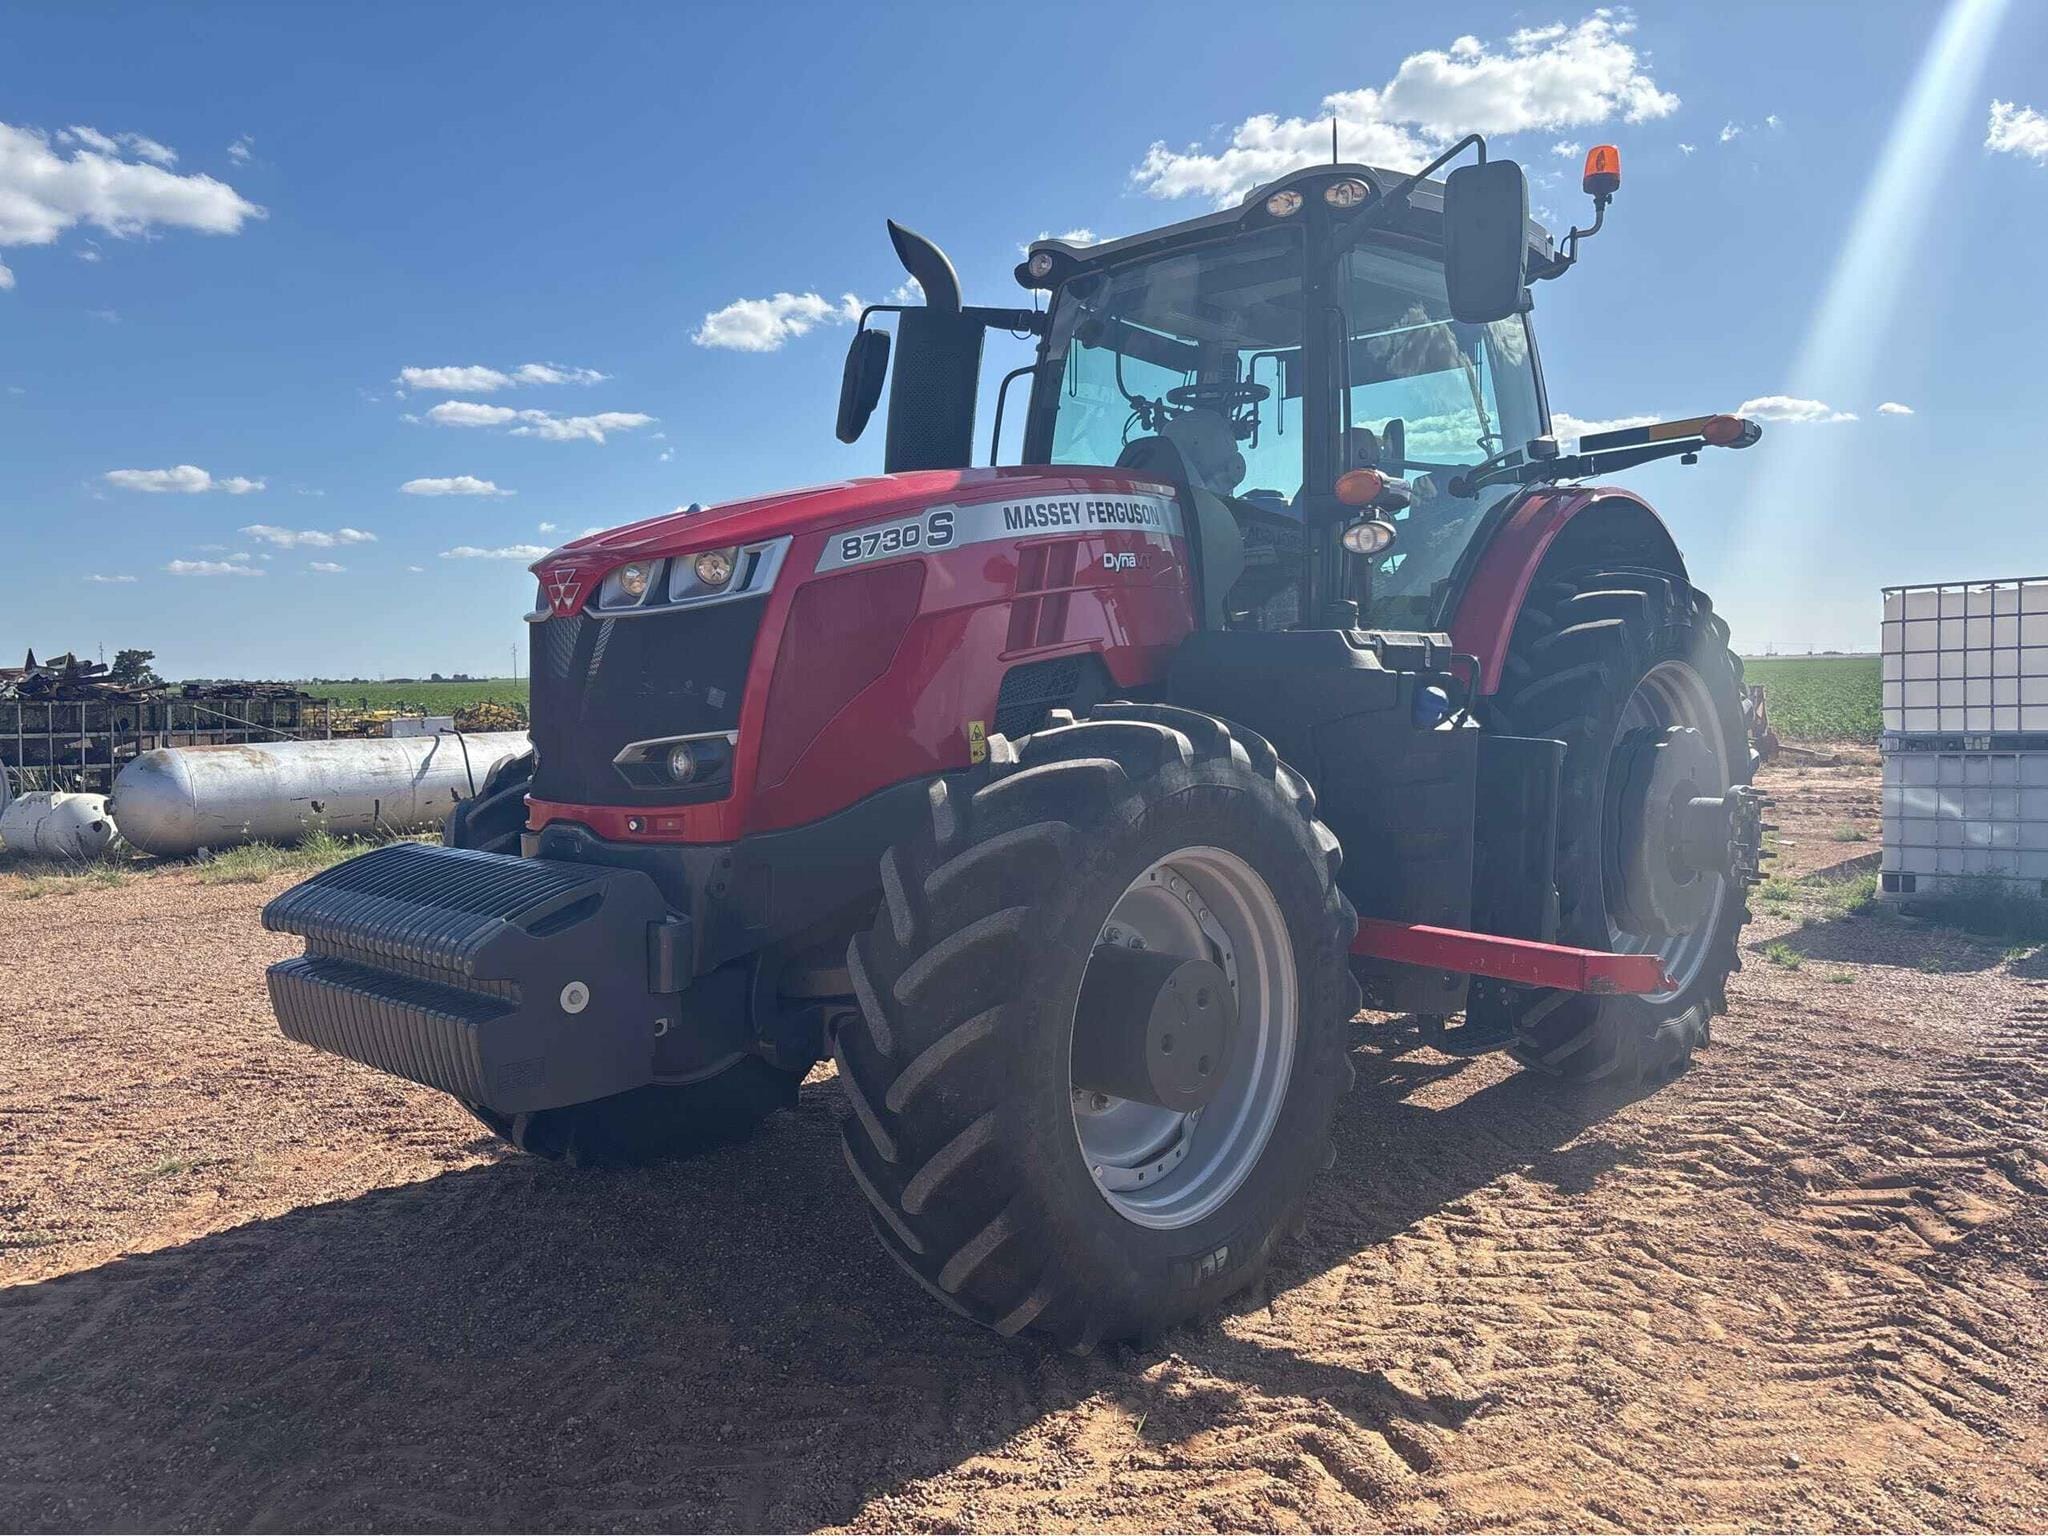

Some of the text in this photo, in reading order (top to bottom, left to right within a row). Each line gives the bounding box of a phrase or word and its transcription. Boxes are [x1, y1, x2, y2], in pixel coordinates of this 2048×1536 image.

[1003, 501, 1160, 530] MASSEY FERGUSON
[841, 510, 955, 562] 8730 S
